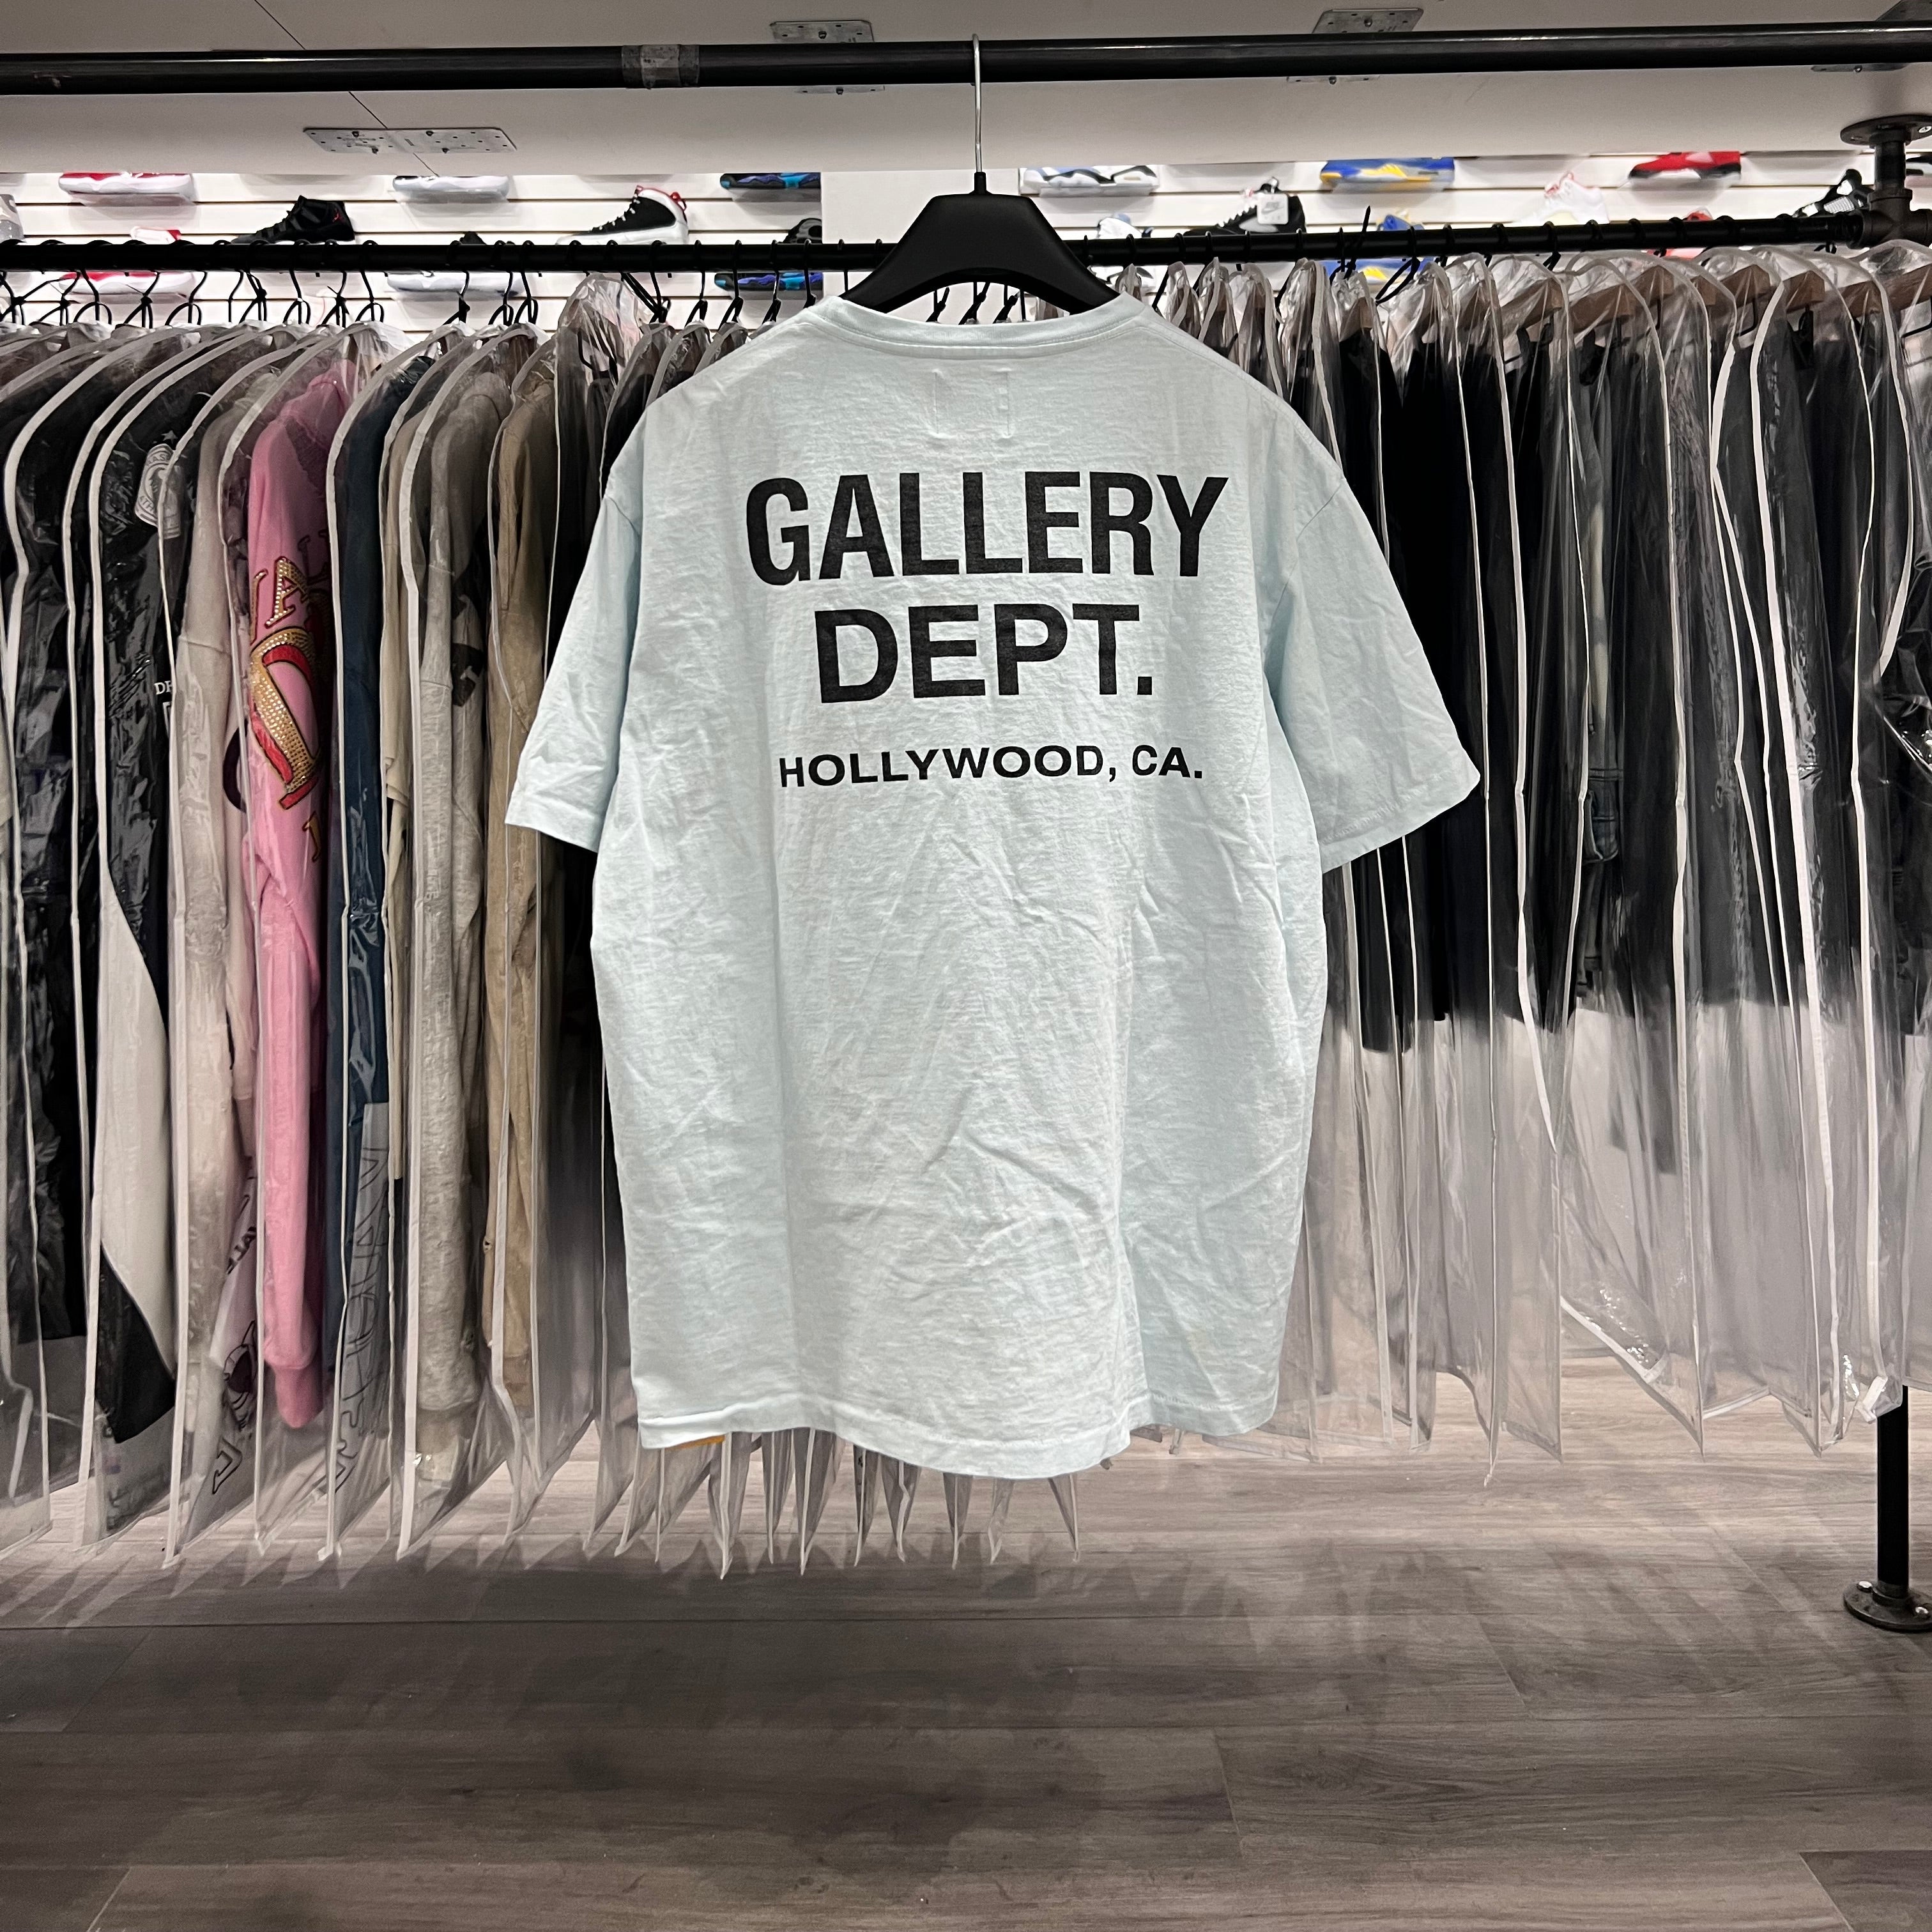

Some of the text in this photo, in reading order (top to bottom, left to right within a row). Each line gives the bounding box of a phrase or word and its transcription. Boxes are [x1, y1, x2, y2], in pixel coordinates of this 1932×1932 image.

[746, 471, 1229, 586] GALLERY
[814, 602, 1153, 703] DEPT.
[779, 744, 1202, 788] HOLLYWOOD, CA.
